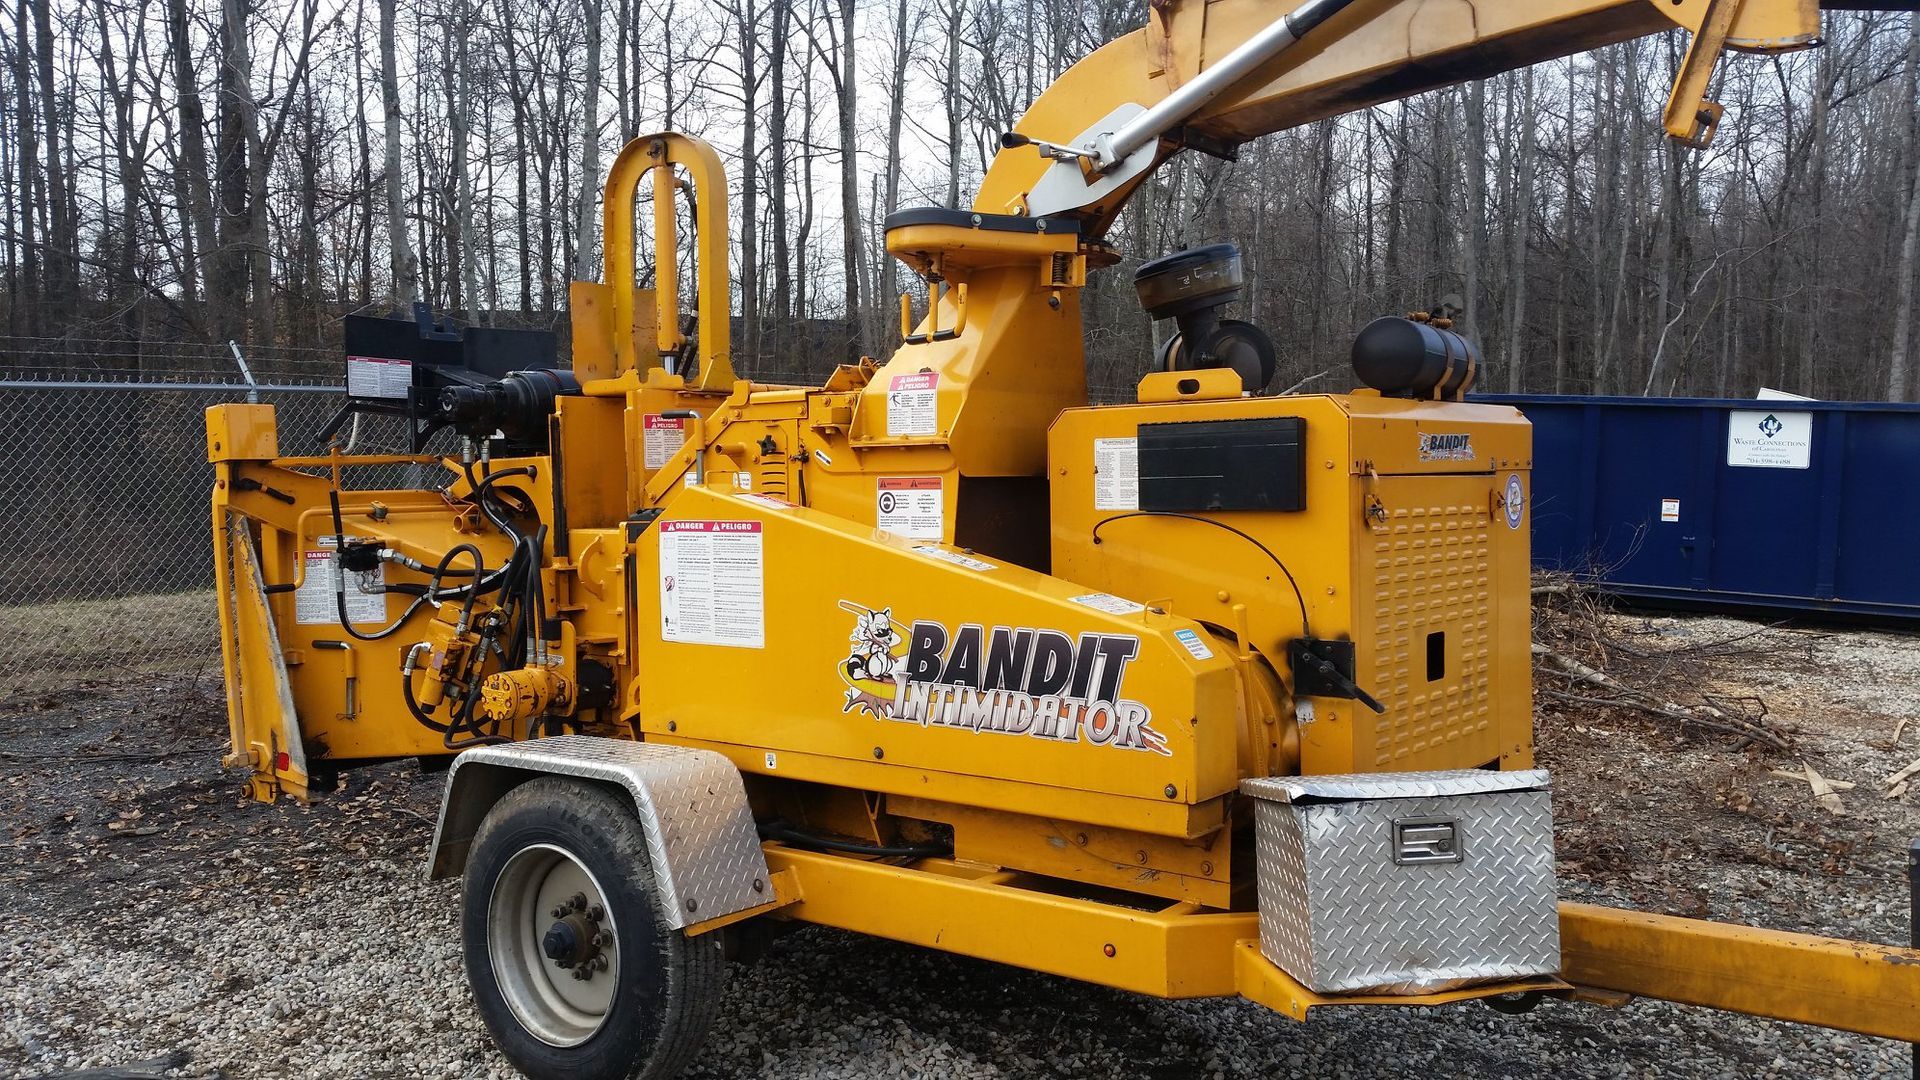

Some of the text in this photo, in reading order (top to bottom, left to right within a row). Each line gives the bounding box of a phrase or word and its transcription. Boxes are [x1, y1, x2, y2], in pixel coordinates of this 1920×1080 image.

[1429, 435, 1470, 450] BANDIT
[675, 522, 704, 530] DANGER
[906, 621, 1140, 703] BANDIT
[891, 672, 1151, 751] INTIMIDATOR
